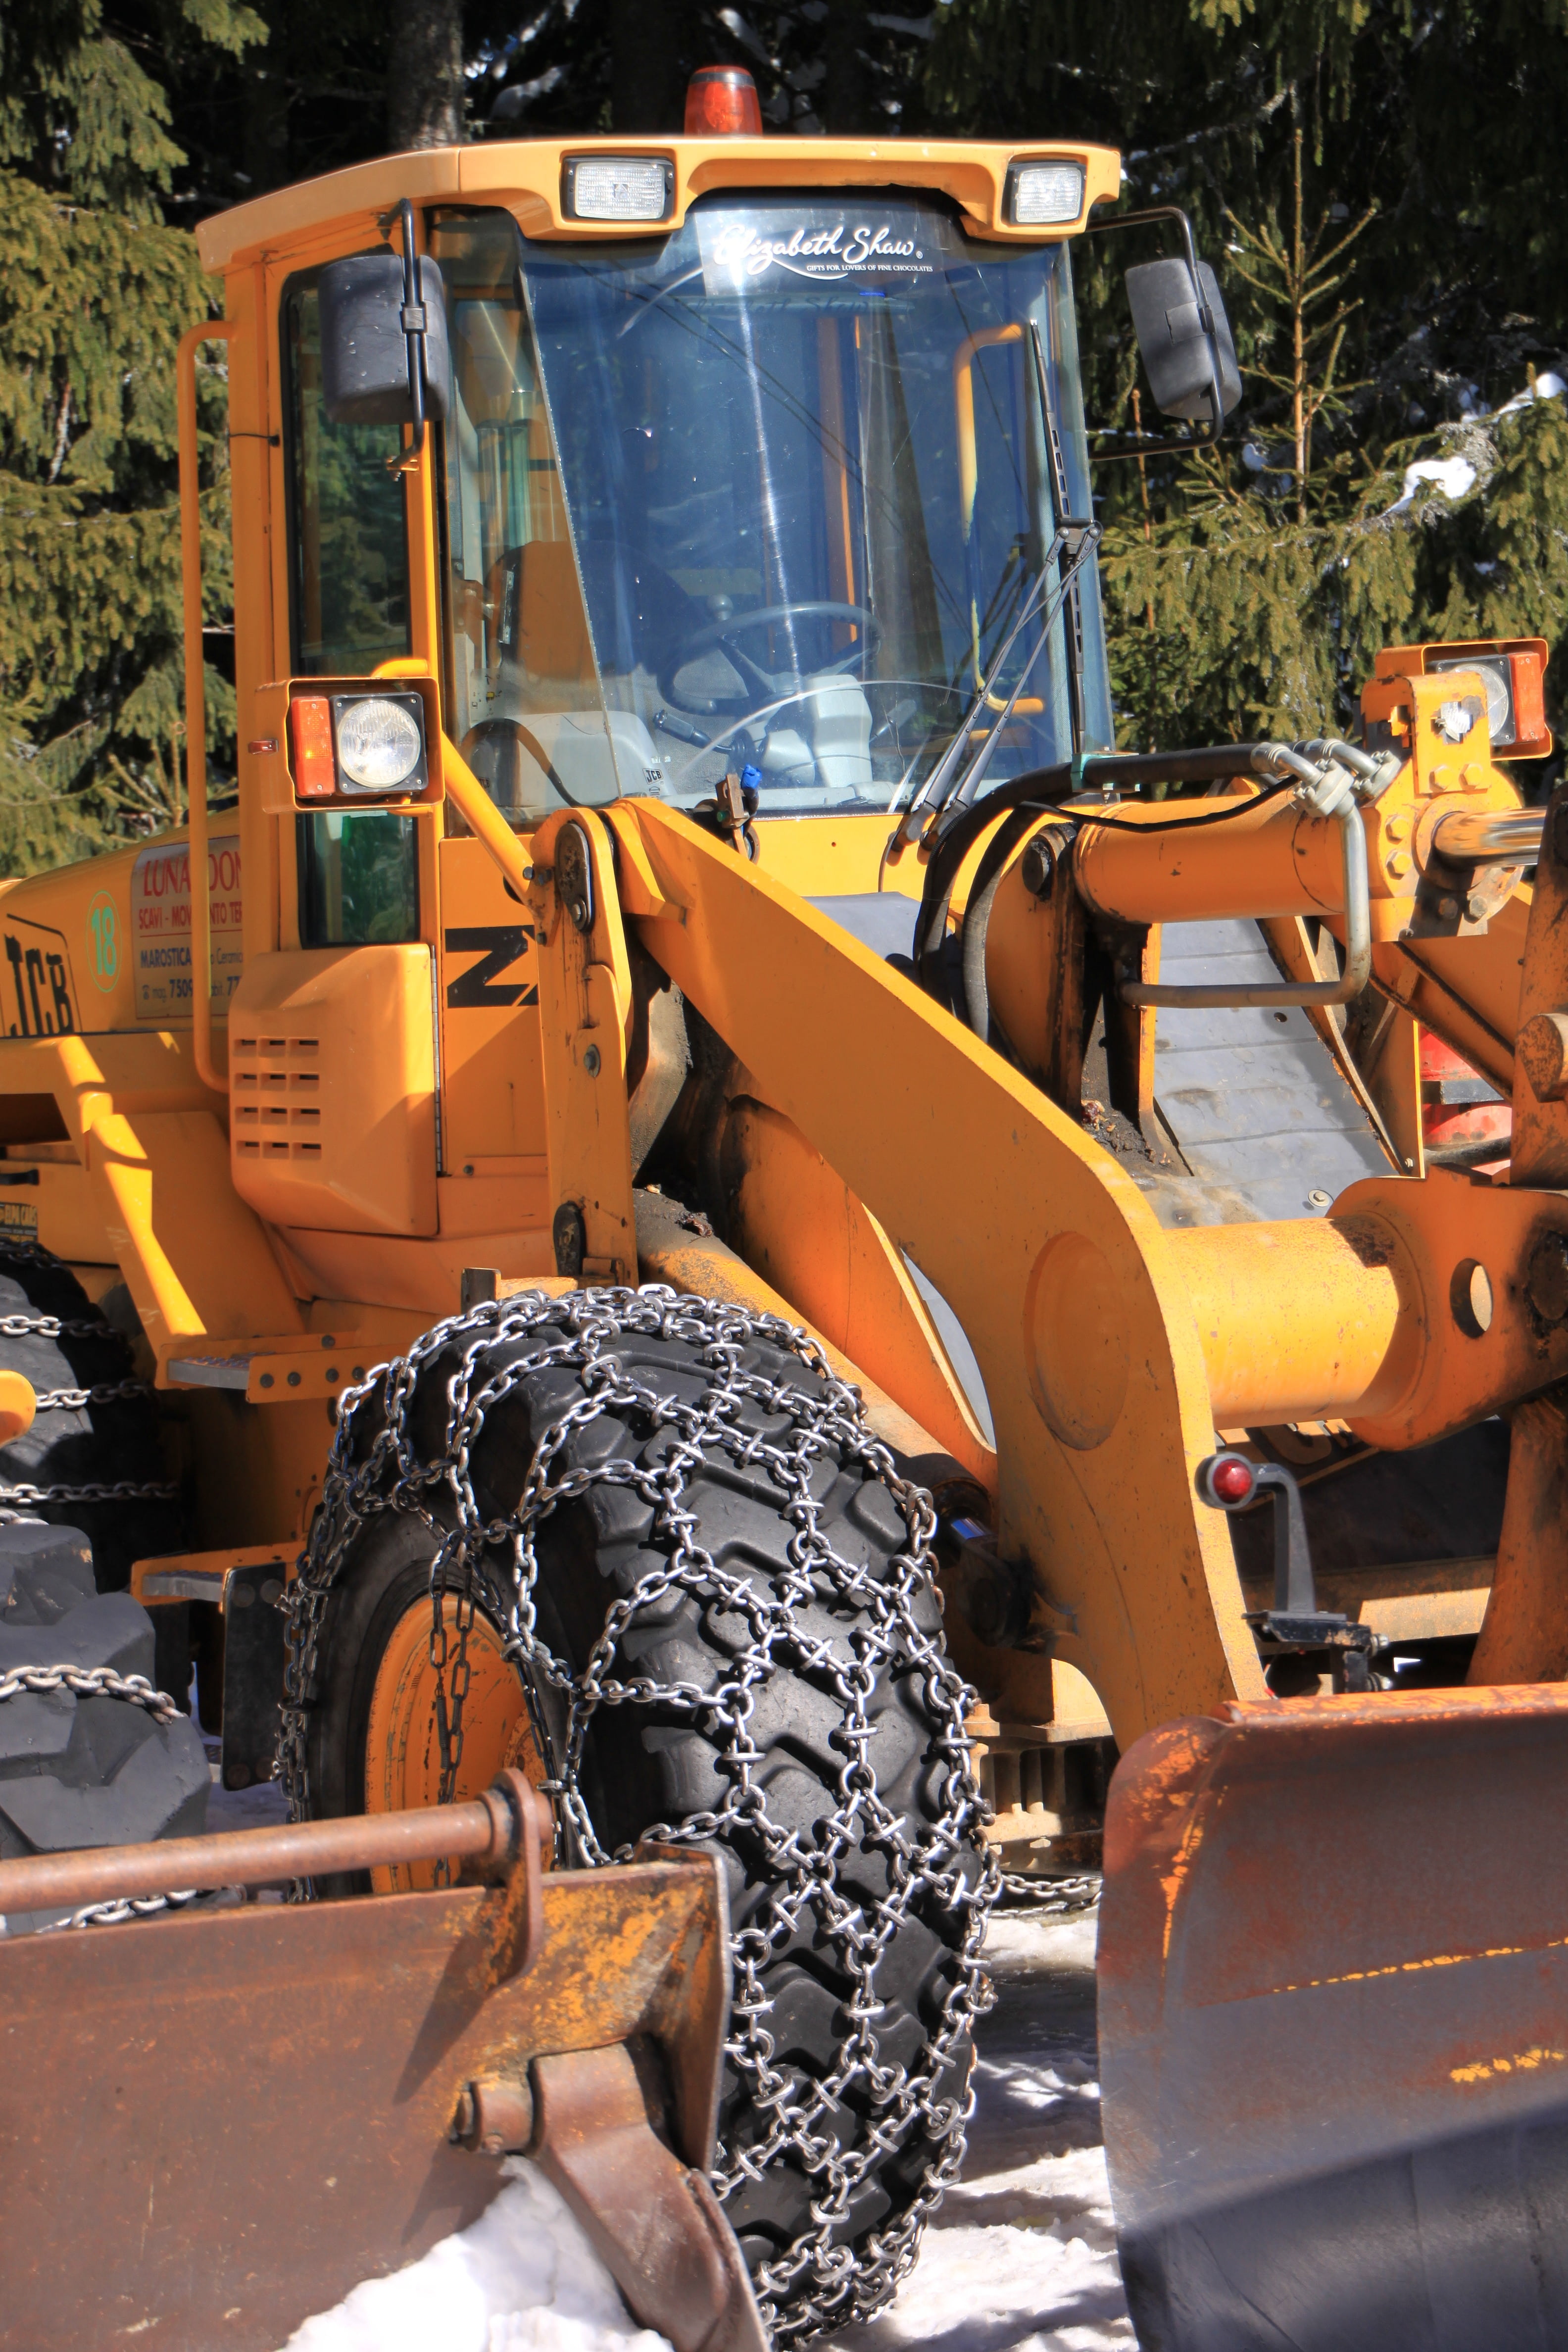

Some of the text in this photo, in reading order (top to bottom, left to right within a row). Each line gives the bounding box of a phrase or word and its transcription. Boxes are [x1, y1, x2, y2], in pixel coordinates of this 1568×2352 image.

[713, 225, 914, 275] Elizabeth Shaw
[645, 770, 662, 783] JCB
[139, 907, 162, 930] SCAVI
[91, 906, 117, 977] 18
[141, 946, 192, 969] MAROSTICA
[4, 932, 75, 1036] JCB
